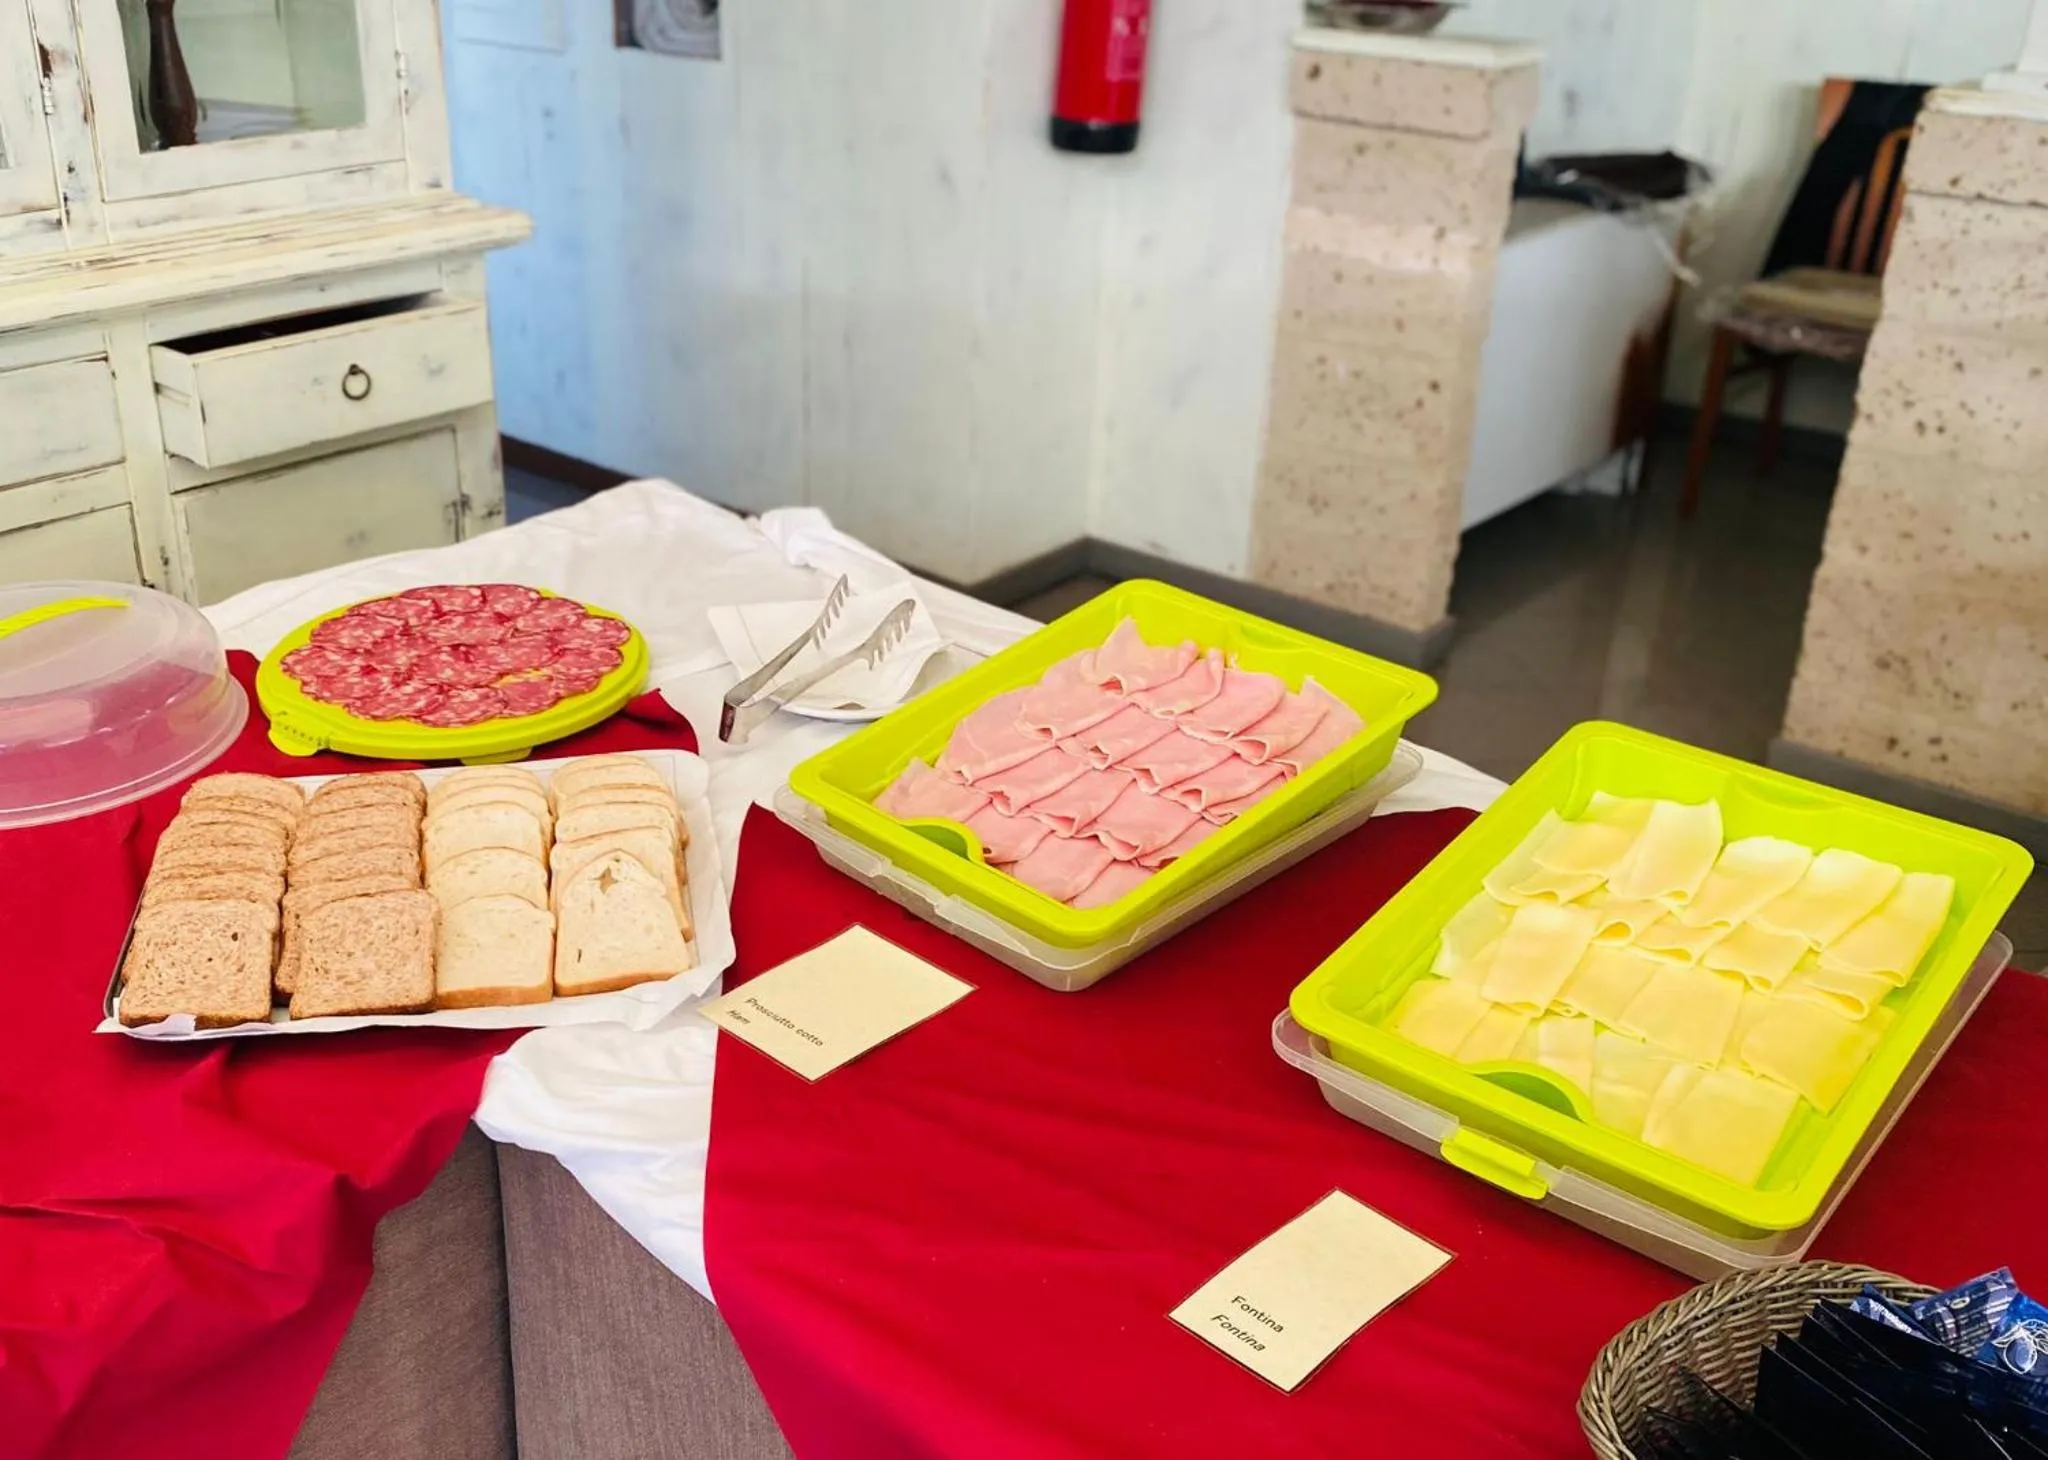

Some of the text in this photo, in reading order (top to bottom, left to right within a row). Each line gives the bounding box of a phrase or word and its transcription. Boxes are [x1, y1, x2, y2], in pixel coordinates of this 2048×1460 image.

[745, 997, 824, 1046] Prosciutto cotto
[1211, 1314, 1266, 1351] Fontina
[1231, 1295, 1284, 1333] Fontina
